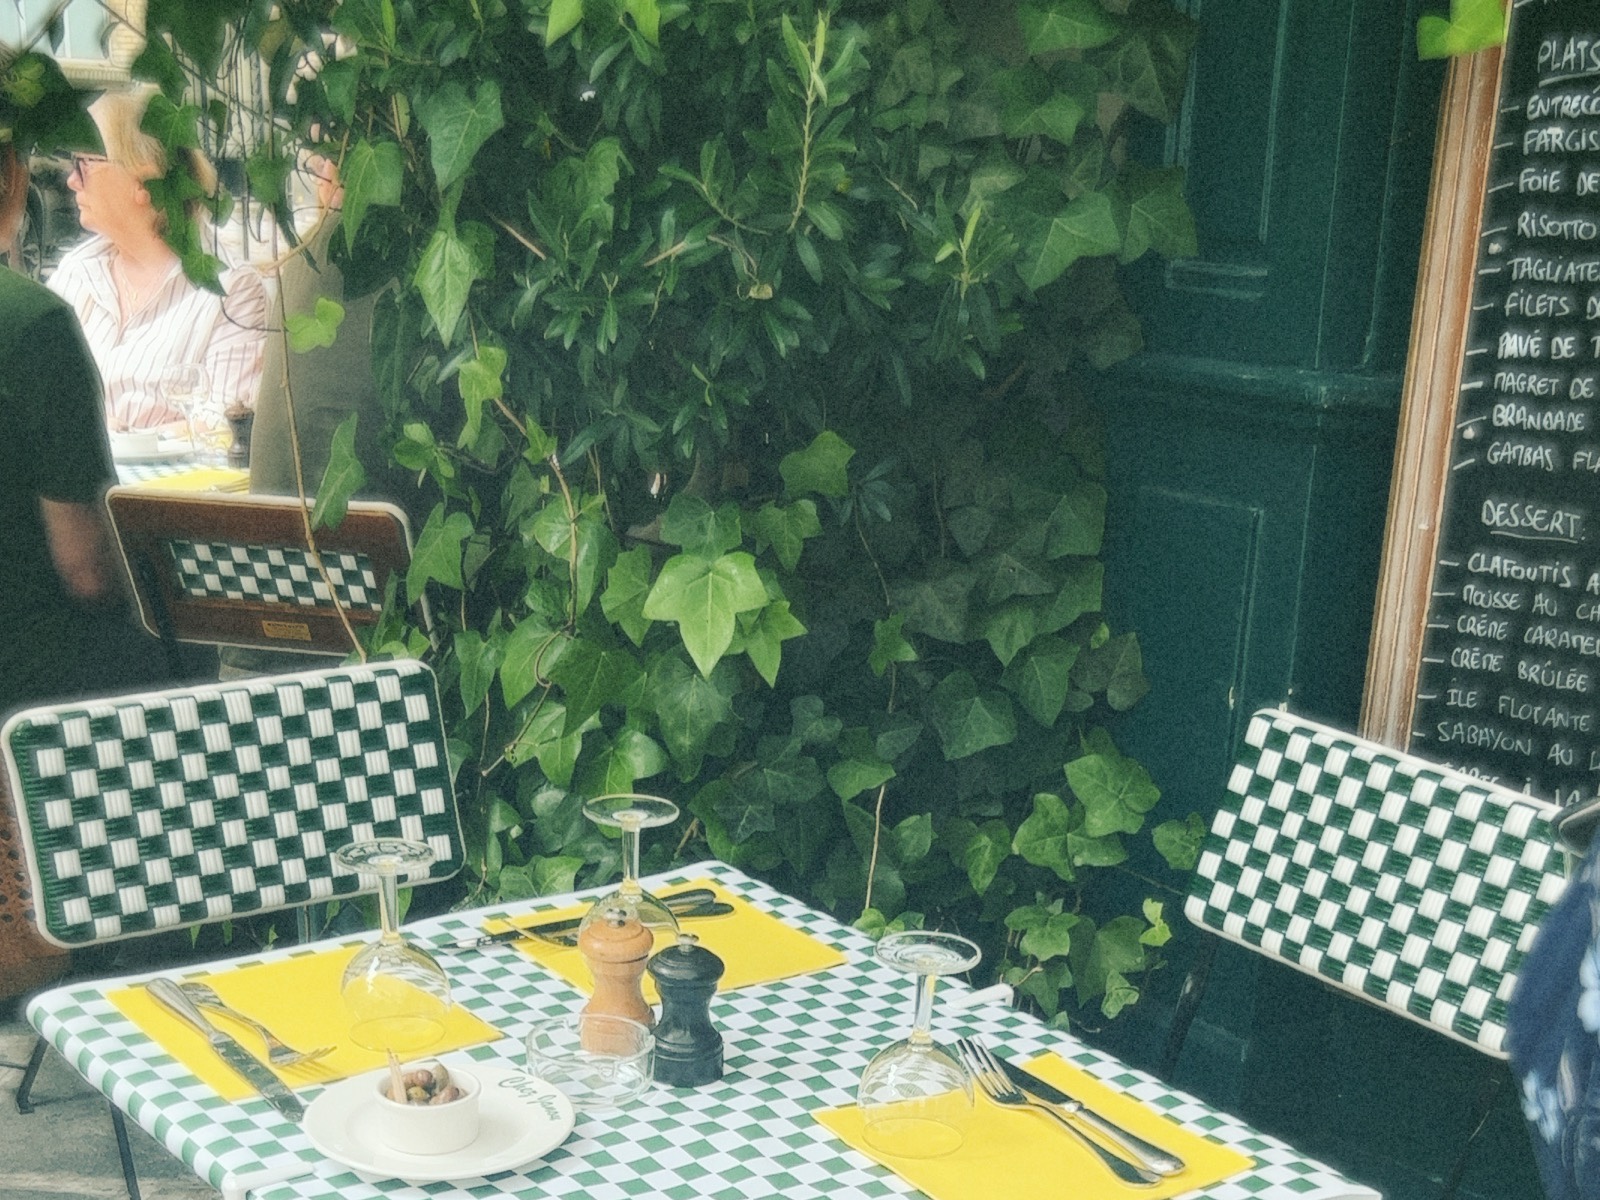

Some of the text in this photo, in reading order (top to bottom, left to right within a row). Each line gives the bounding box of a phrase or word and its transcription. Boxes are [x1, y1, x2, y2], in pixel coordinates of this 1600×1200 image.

[1551, 336, 1576, 360] DE
[1494, 372, 1594, 400] MAGRET DE
[1487, 441, 1553, 472] GAMBAS
[1462, 584, 1521, 611] MOUSSE
[1532, 592, 1558, 617] AU
[1437, 721, 1531, 757] SABAYON
[1547, 743, 1573, 766] AU
[498, 1076, 538, 1098] Chez
